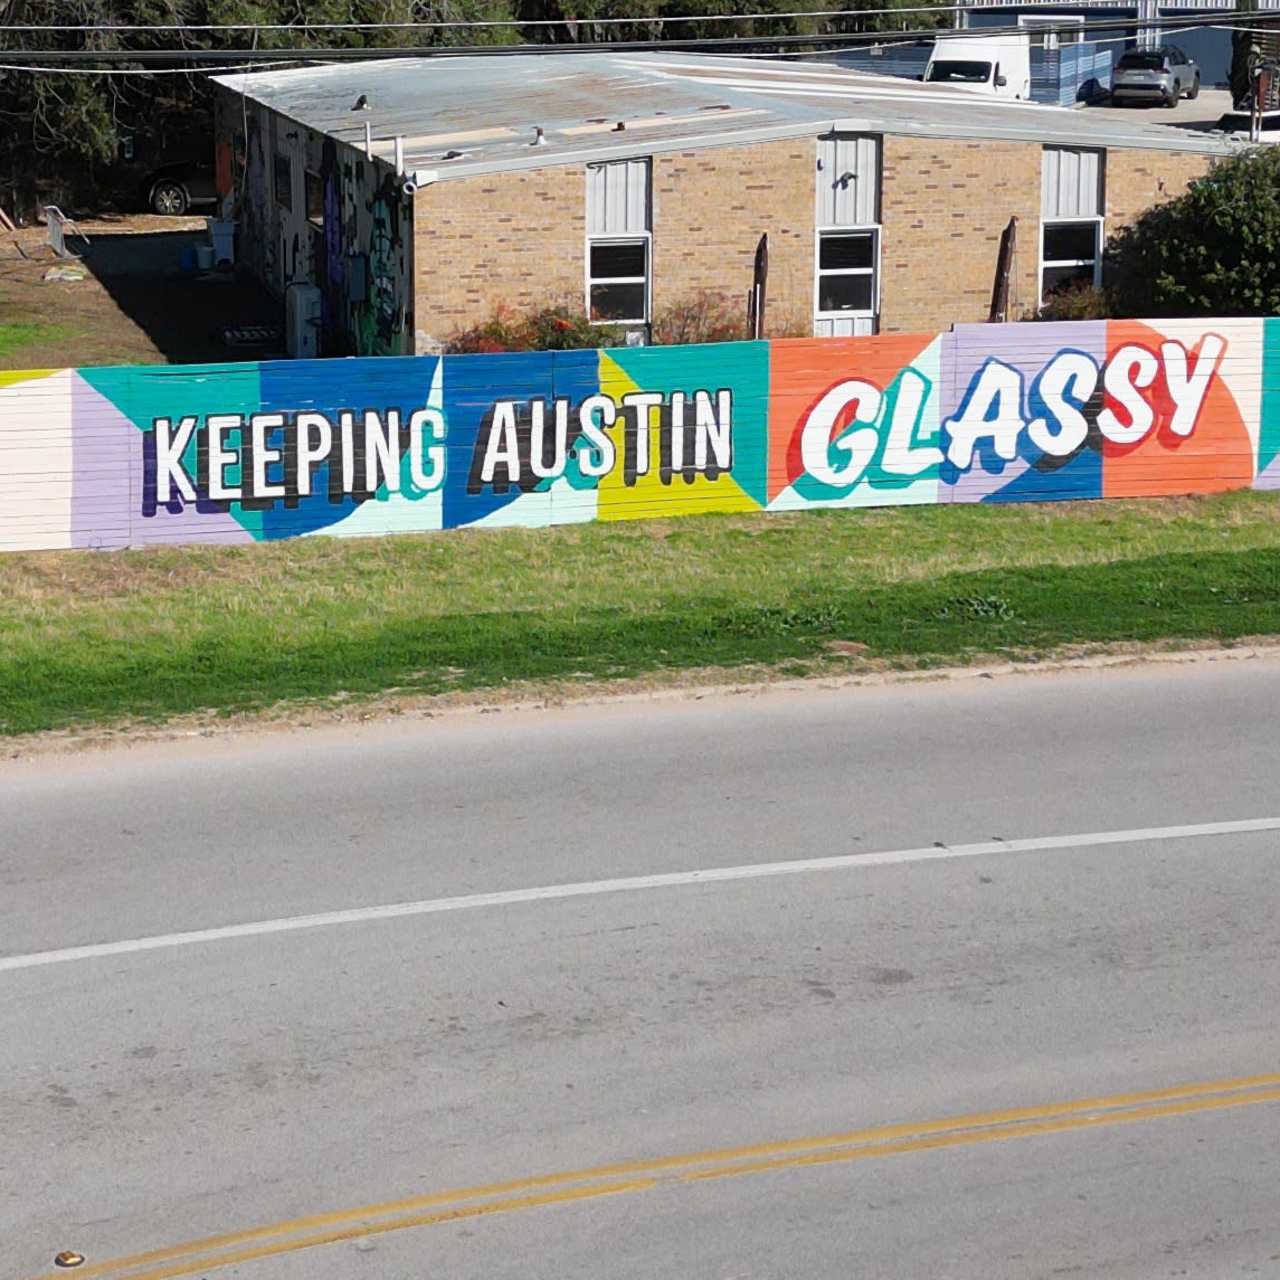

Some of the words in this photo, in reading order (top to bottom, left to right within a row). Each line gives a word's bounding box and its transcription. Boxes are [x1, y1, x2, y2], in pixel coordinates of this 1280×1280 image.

[155, 410, 445, 503] KEEPING
[480, 388, 732, 483] AUSTIN
[800, 334, 1222, 487] GLASSY
